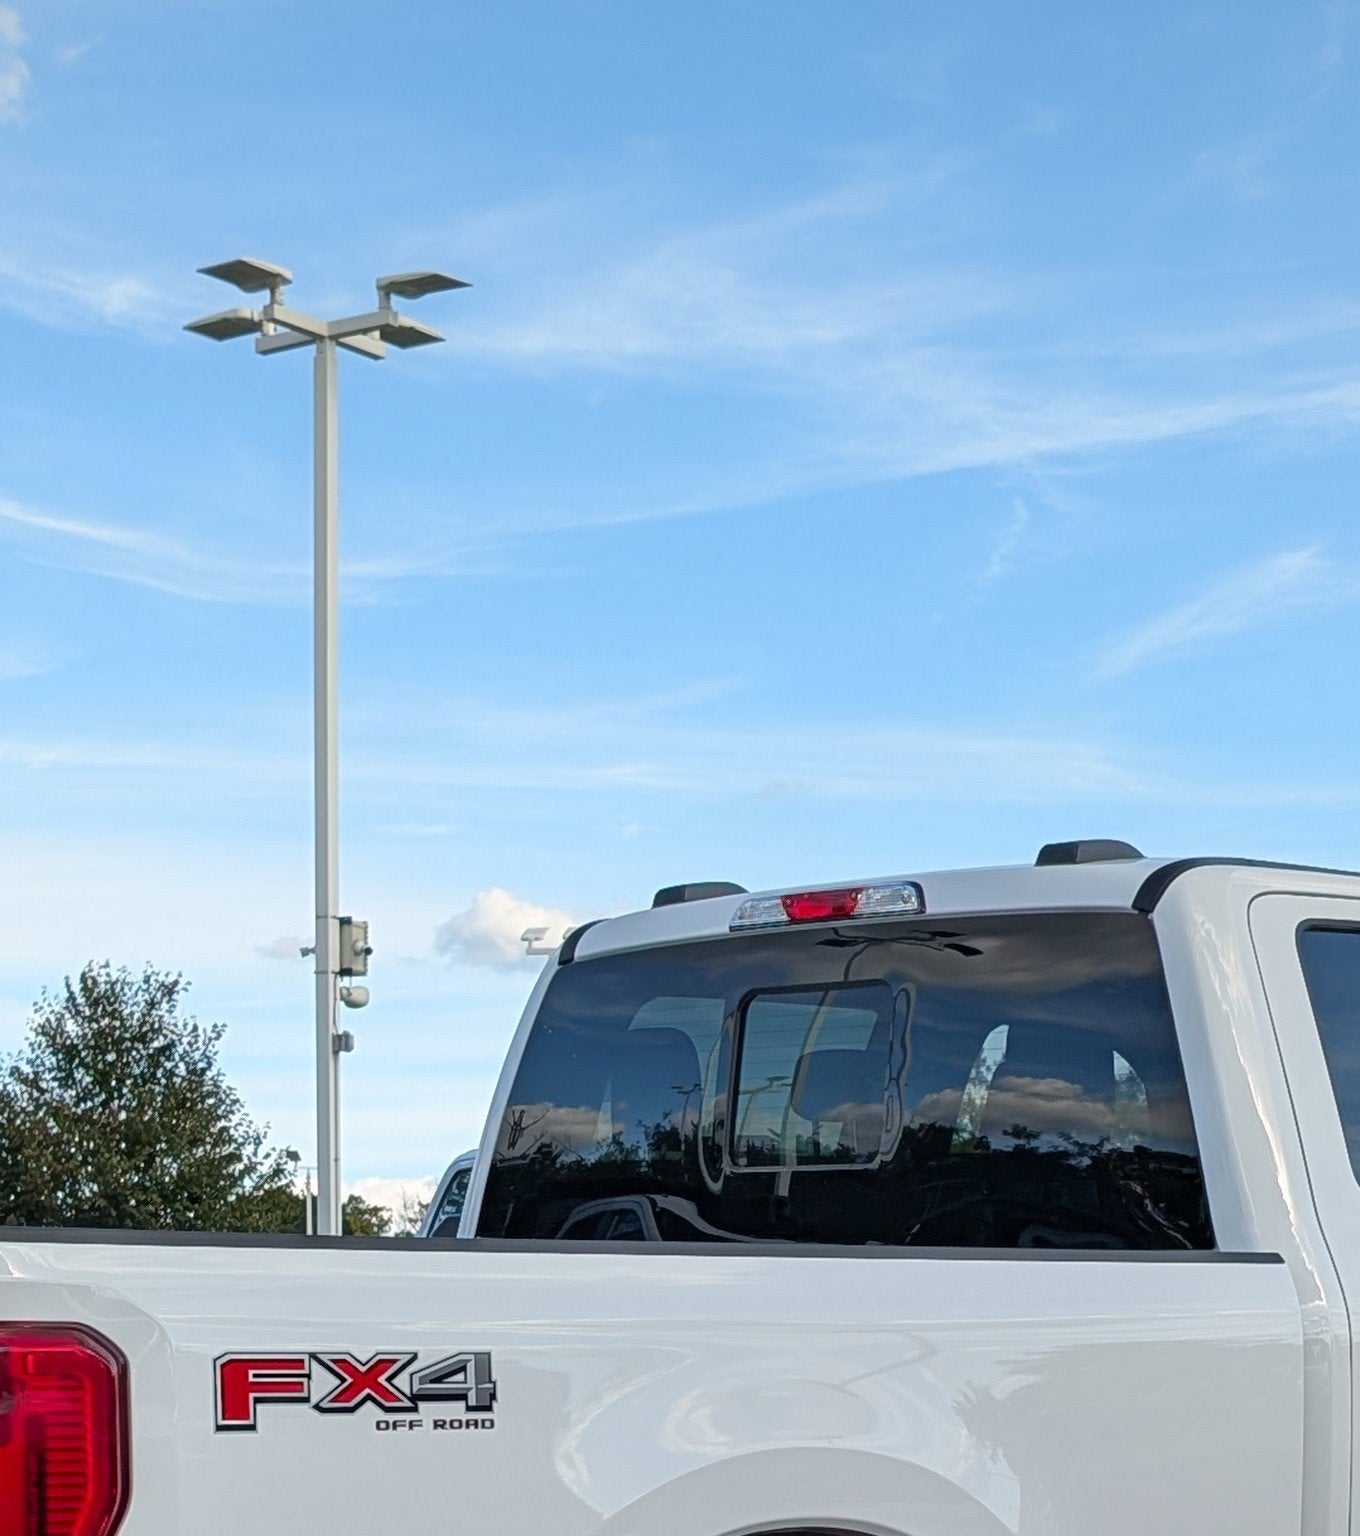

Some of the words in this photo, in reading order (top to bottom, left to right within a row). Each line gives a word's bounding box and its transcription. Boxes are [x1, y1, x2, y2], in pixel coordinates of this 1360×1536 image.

[214, 1352, 497, 1433] FX4
[375, 1418, 424, 1431] OFF
[432, 1418, 495, 1431] ROAD
